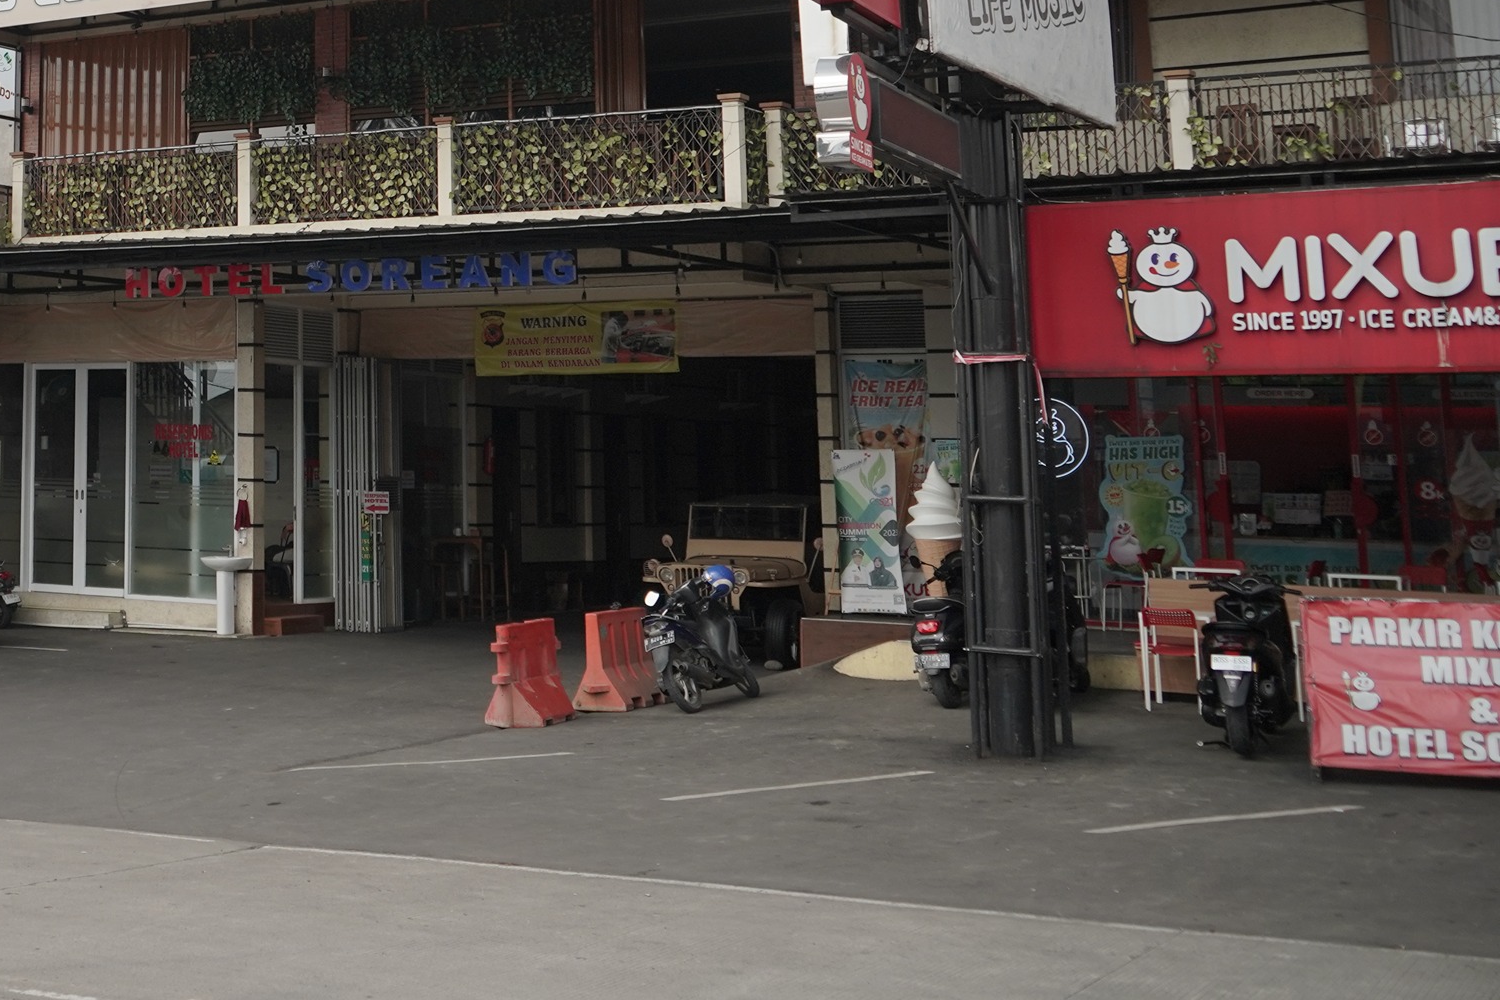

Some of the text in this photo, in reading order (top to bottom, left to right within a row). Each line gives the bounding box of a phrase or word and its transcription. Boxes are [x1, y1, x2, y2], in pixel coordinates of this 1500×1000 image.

[851, 136, 864, 153] SINCE
[125, 250, 578, 299] HOTEL SOREANG
[520, 315, 588, 330] WARNING
[1233, 306, 1500, 332] SINCE 1997 ICE CREAM&
[506, 334, 594, 346] JANGAN MENYIMPAN
[507, 346, 592, 357] BARANG BERHARGA
[501, 358, 601, 369] DI DALAM KENDARAAN
[851, 378, 927, 393] ICE REAL
[850, 395, 925, 407] FRUIT TEA
[154, 424, 213, 440] RESEPSIONIS
[168, 441, 199, 458] HOTEL
[1109, 446, 1180, 460] HAS HIGH
[1328, 616, 1463, 649] PARKIR
[1469, 697, 1499, 725] &
[1341, 723, 1455, 760] HOTEL
